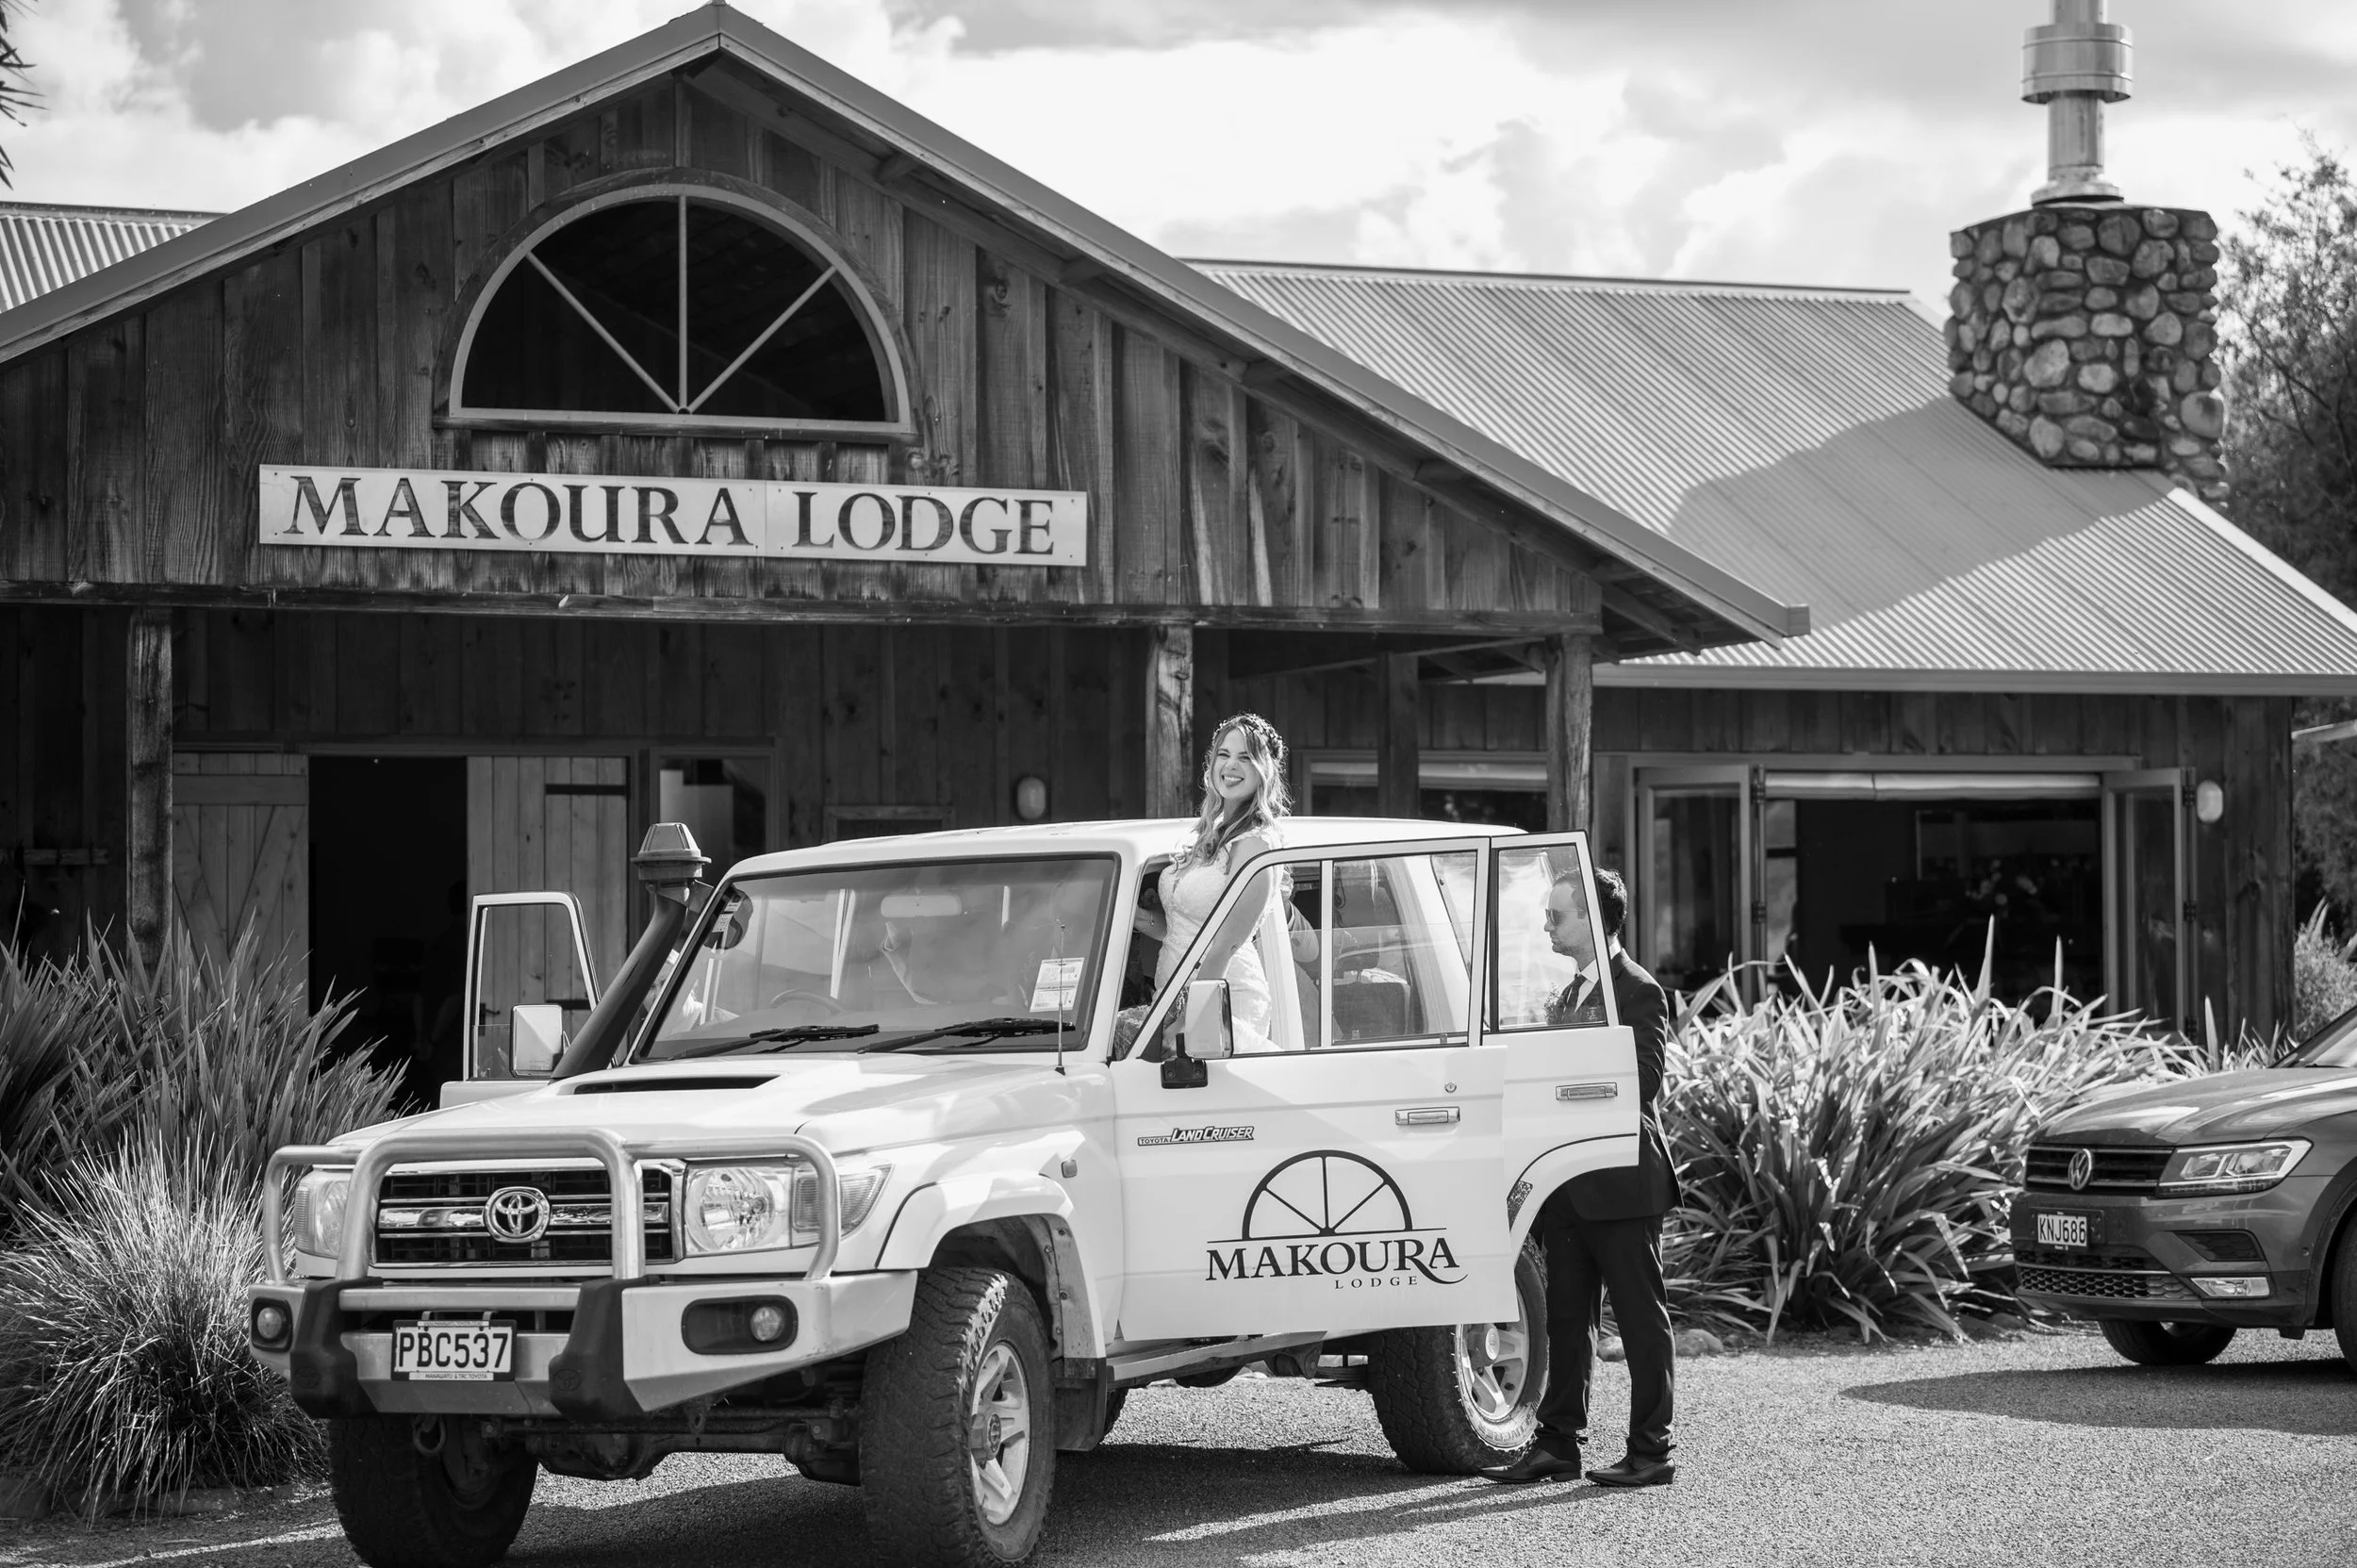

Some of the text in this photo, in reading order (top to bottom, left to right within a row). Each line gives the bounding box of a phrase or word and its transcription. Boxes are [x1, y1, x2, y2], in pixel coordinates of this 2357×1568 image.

[283, 475, 1054, 556] MAKOURA LODGE
[2039, 1217, 2085, 1244] KNJ686
[1206, 1237, 1469, 1285] MAKOURA
[1335, 1276, 1418, 1290] LODGE
[398, 1332, 509, 1369] PBC537
